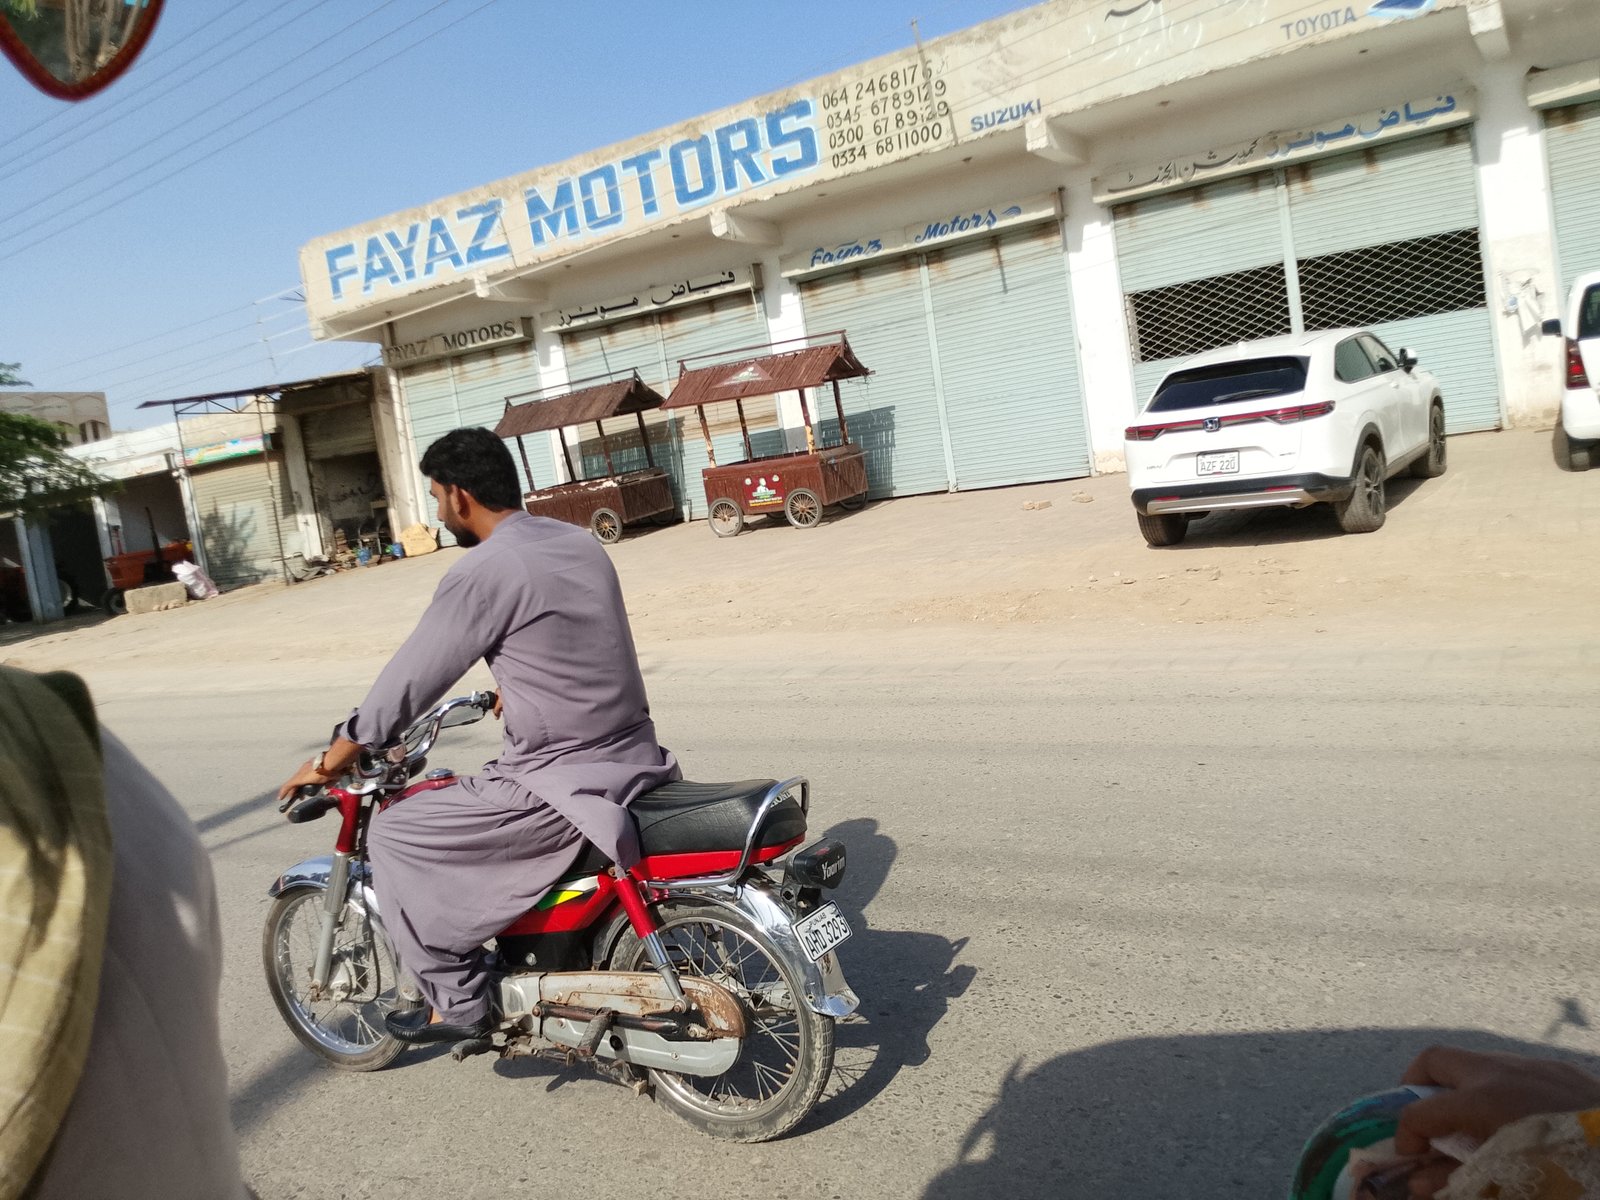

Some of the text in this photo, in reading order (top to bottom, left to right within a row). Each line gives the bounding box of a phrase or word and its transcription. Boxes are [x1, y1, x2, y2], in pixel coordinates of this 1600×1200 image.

[1279, 6, 1357, 40] TOYOTA
[822, 88, 848, 110] 064
[827, 104, 862, 129] 0345
[970, 98, 1041, 132] SUZUKI
[829, 124, 863, 149] 0300
[832, 122, 942, 168] 0334 6811000
[325, 98, 819, 303] FAYAZ MOTORS
[811, 208, 997, 267] Fayaz Motors
[442, 321, 517, 352] MOTORS
[1200, 460, 1217, 472] AZF
[805, 929, 828, 957] AHD
